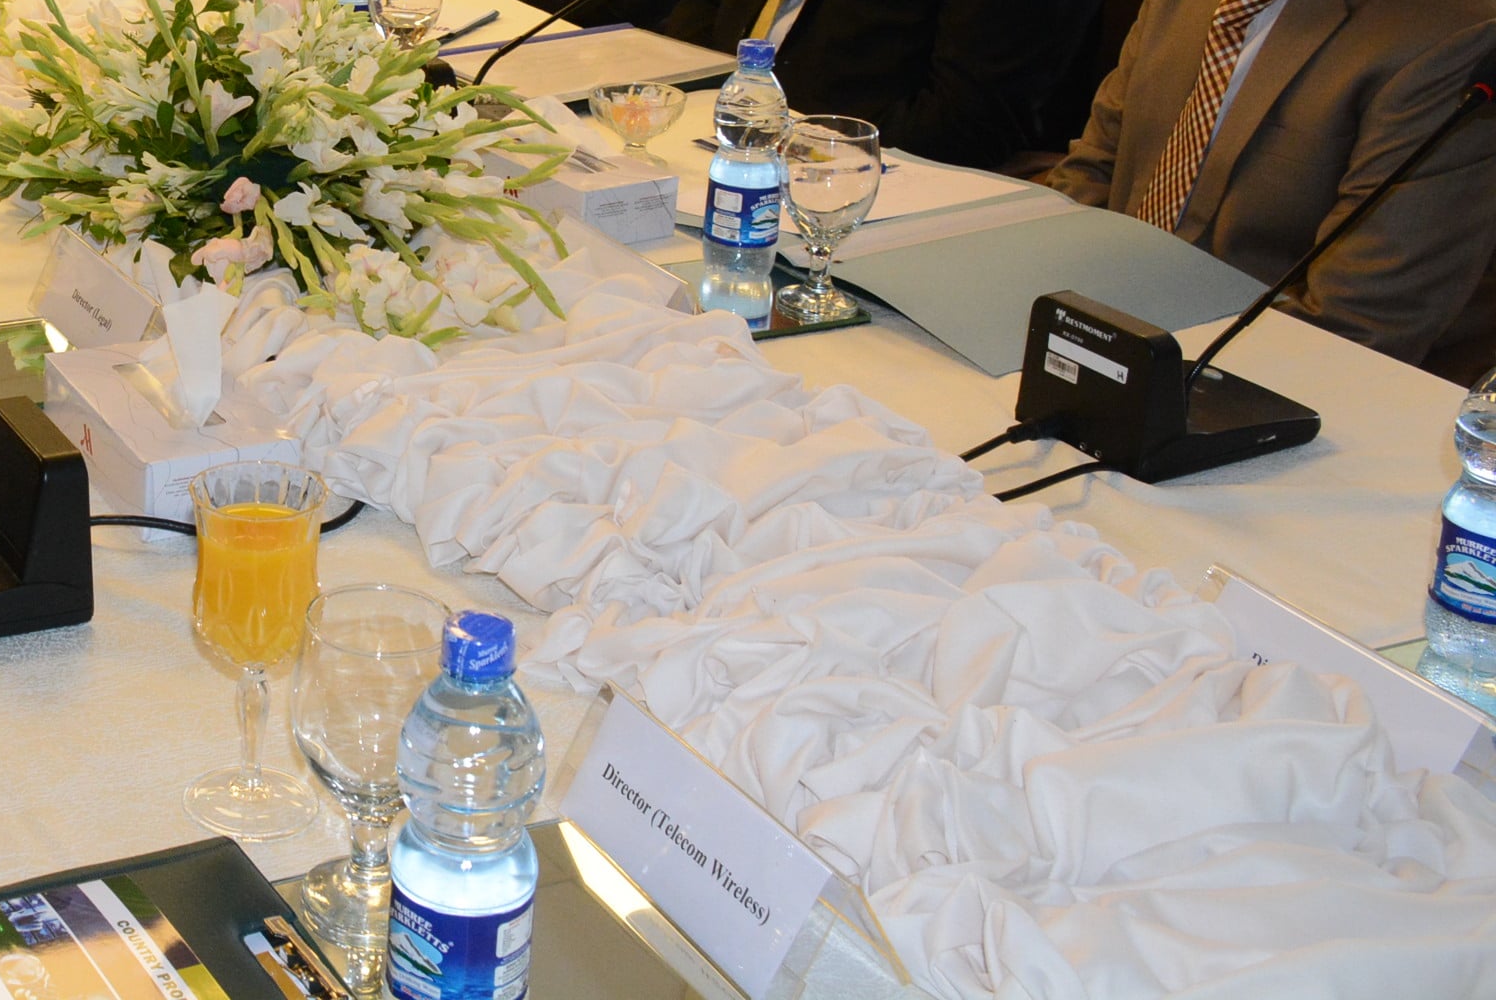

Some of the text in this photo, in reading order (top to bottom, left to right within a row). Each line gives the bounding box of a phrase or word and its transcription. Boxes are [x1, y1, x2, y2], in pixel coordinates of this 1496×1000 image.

[602, 762, 771, 926] Director (Telecom Wireless)
[117, 920, 164, 971] COUNTRY
